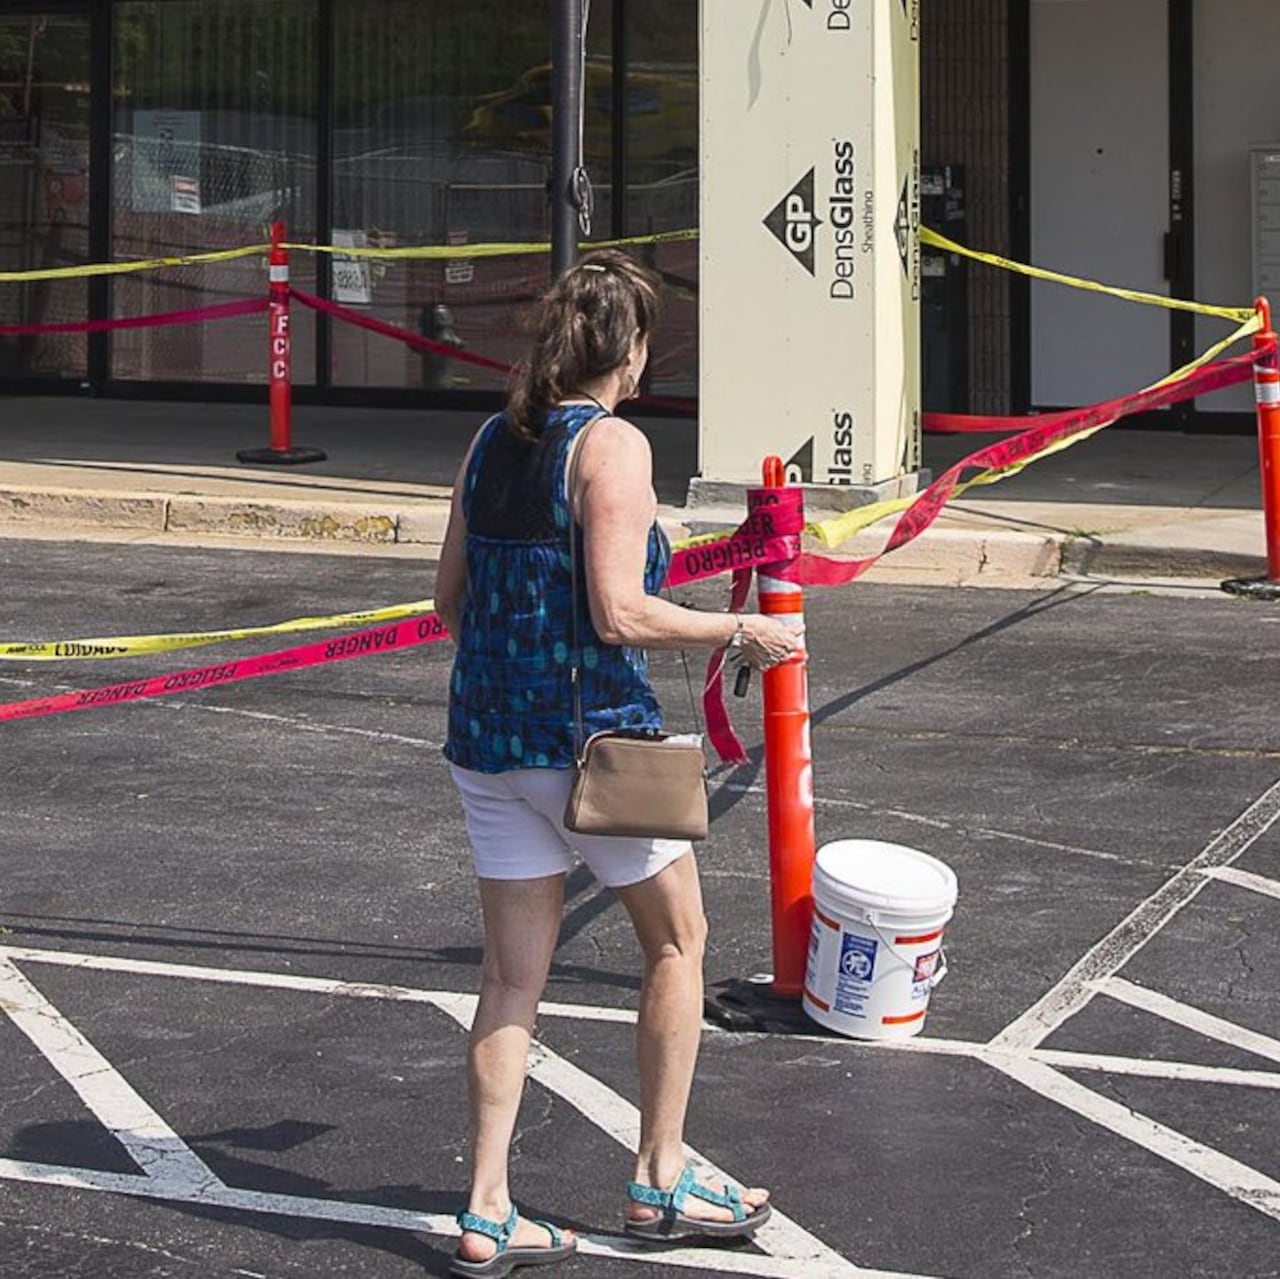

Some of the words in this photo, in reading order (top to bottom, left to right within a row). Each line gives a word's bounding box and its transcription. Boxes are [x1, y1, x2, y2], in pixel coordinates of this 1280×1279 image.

[785, 194, 812, 253] GP
[830, 140, 854, 300] DensGlass
[684, 536, 767, 577] PELIGRO
[324, 627, 399, 659] DANGER
[76, 680, 147, 707] DANGER
[163, 662, 240, 691] PELIGRO
